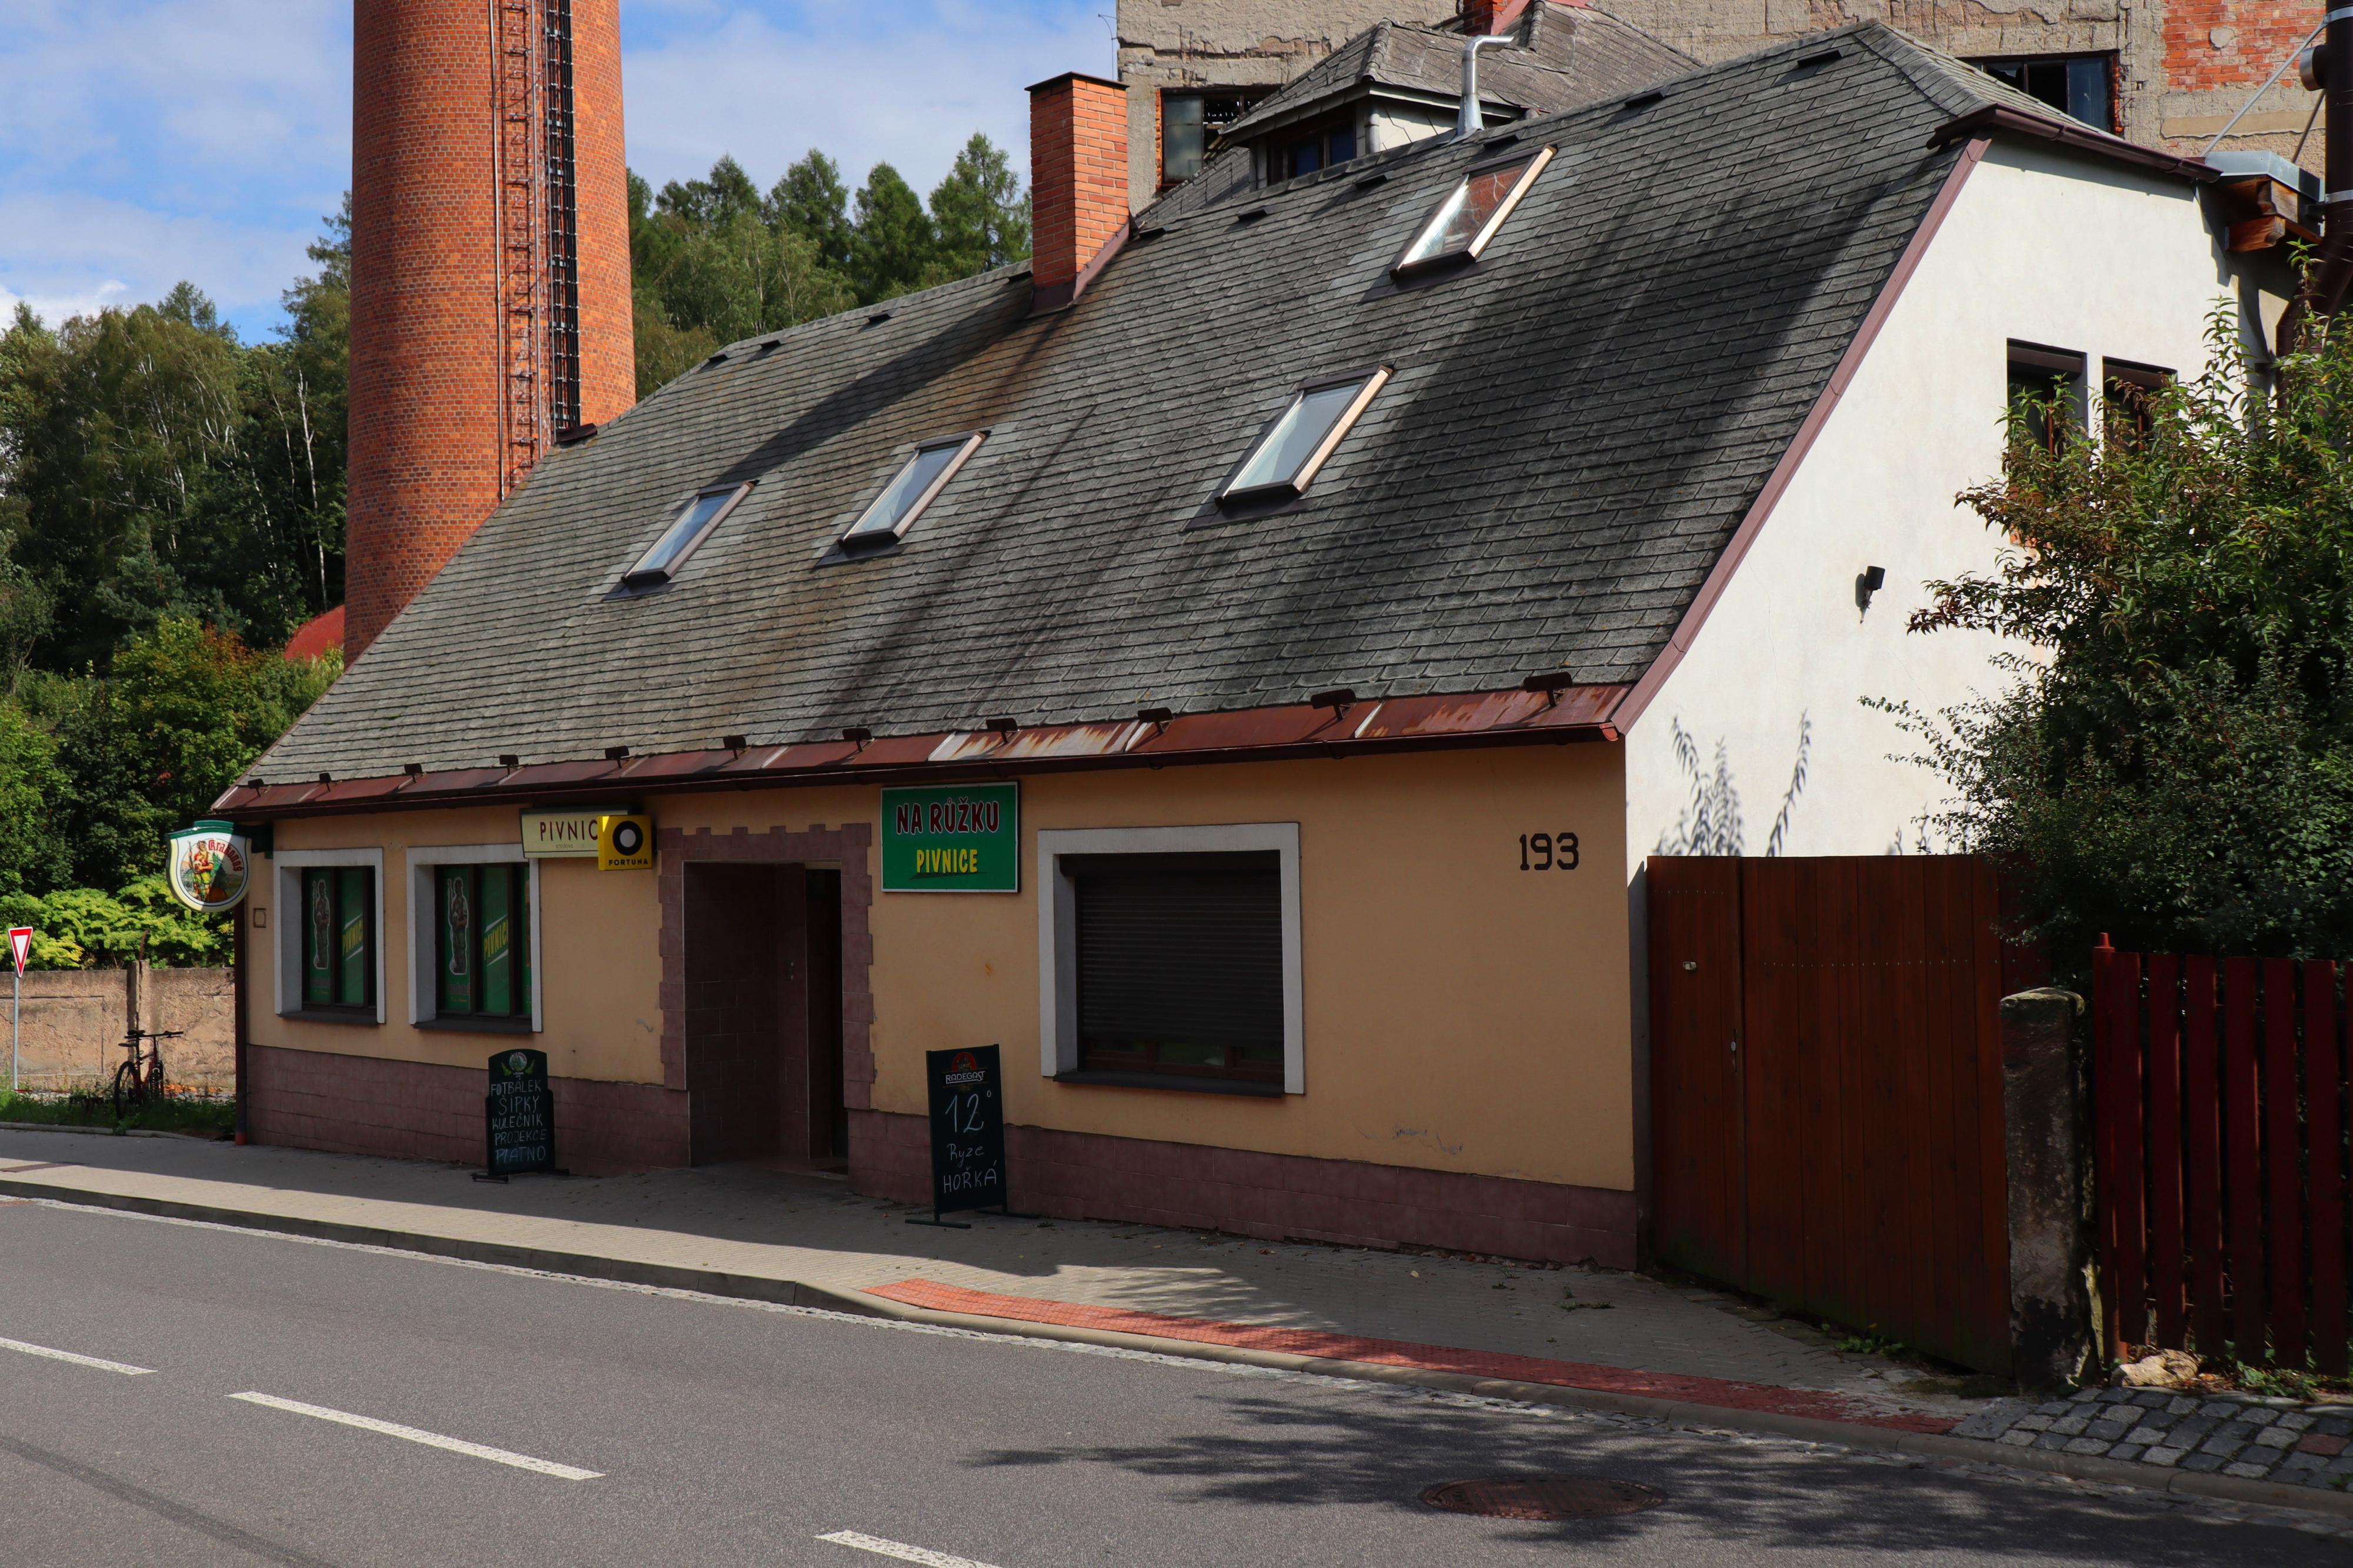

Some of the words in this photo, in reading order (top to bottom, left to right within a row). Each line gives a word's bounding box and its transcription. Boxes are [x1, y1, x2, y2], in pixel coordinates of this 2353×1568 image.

[896, 803, 923, 835] NA
[929, 796, 999, 833] RŮŽKU
[540, 819, 598, 841] PIVNIC
[608, 858, 648, 866] FORTUNA
[916, 848, 978, 874] PIVNICE
[1519, 832, 1579, 870] 193
[342, 919, 363, 956] PIVNIC
[945, 1070, 985, 1085] RADEGAST
[494, 1129, 546, 1146] PROJEKCE
